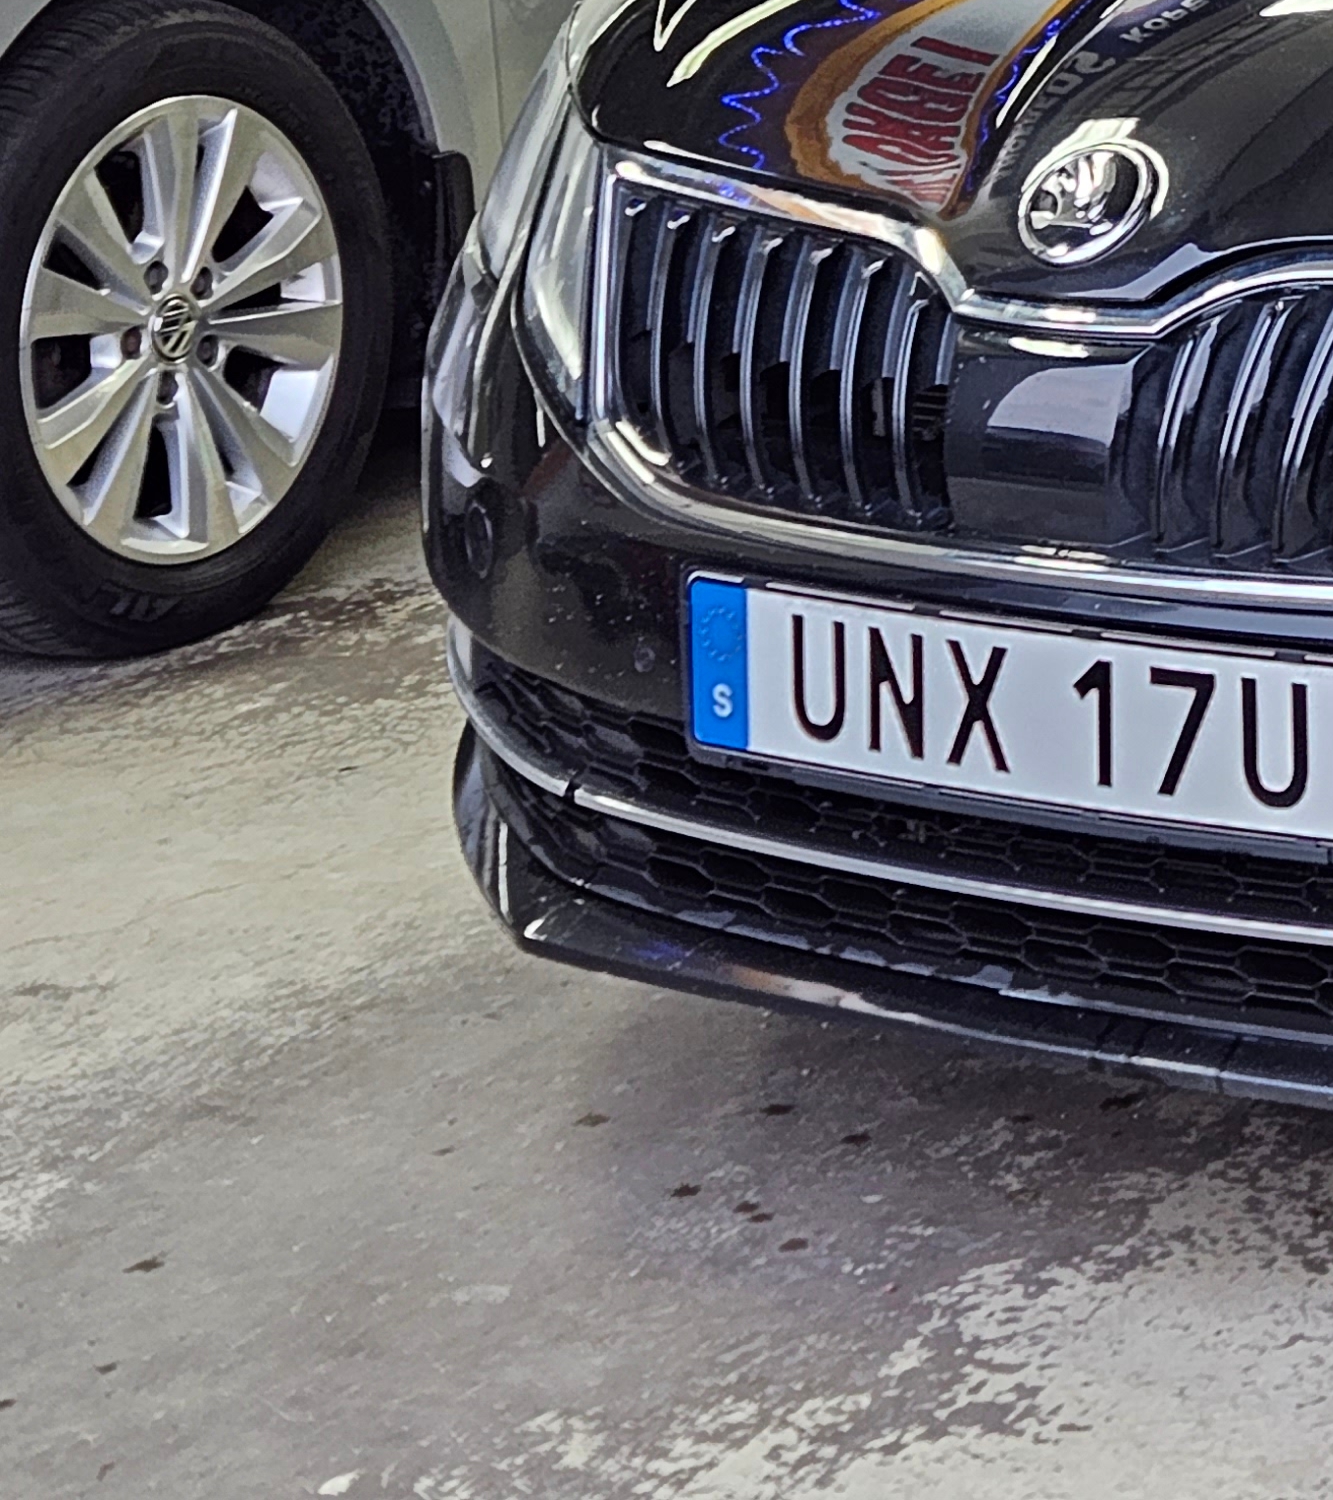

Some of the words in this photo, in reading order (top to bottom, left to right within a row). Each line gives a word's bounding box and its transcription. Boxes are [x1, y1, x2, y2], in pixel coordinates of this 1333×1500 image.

[712, 683, 734, 718] S
[791, 613, 1011, 774] UNX
[1073, 660, 1310, 810] 17U
